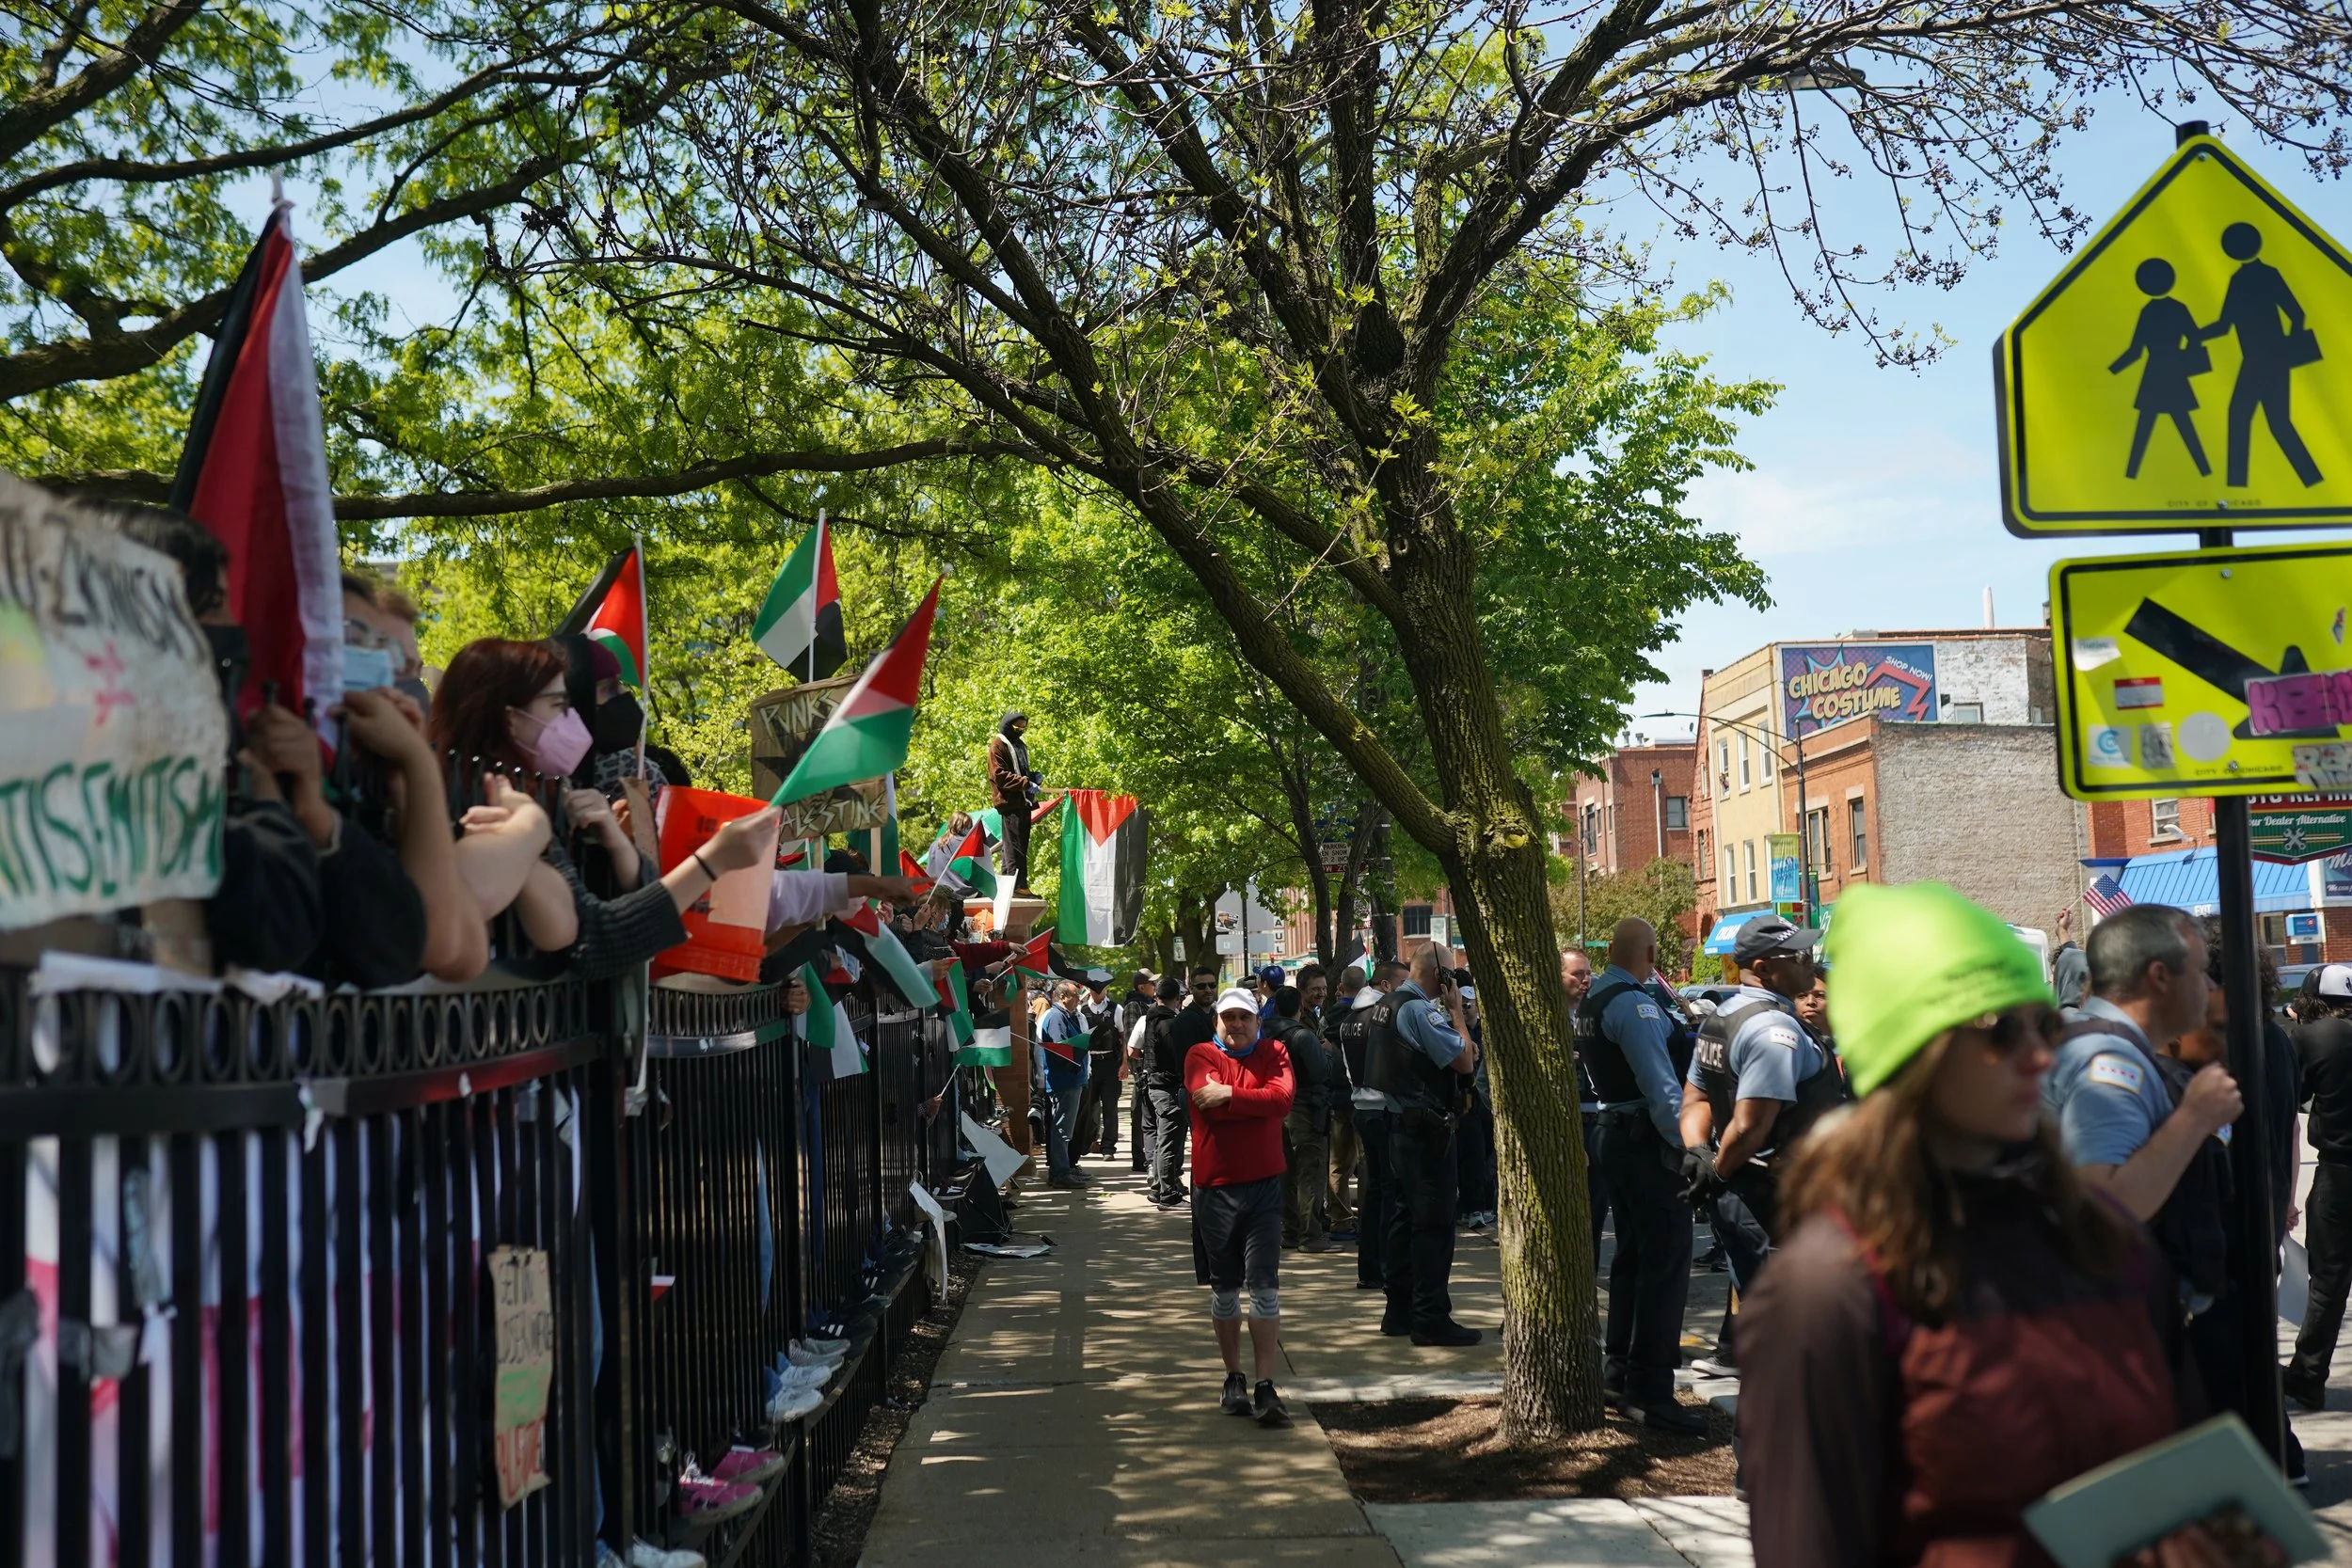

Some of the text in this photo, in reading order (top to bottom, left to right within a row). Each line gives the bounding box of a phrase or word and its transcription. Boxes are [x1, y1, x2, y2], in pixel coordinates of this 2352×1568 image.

[1788, 661, 1867, 699] CHICAGO
[1884, 656, 1933, 682] SHOP NOW!
[759, 689, 841, 741] PUNKS
[1812, 686, 1901, 720] COSTUME
[780, 790, 887, 838] ALESTINE
[2249, 814, 2346, 827] our Dealer Alternative
[1342, 1022, 1363, 1037] POLICE
[1697, 1037, 1724, 1069] POLICE
